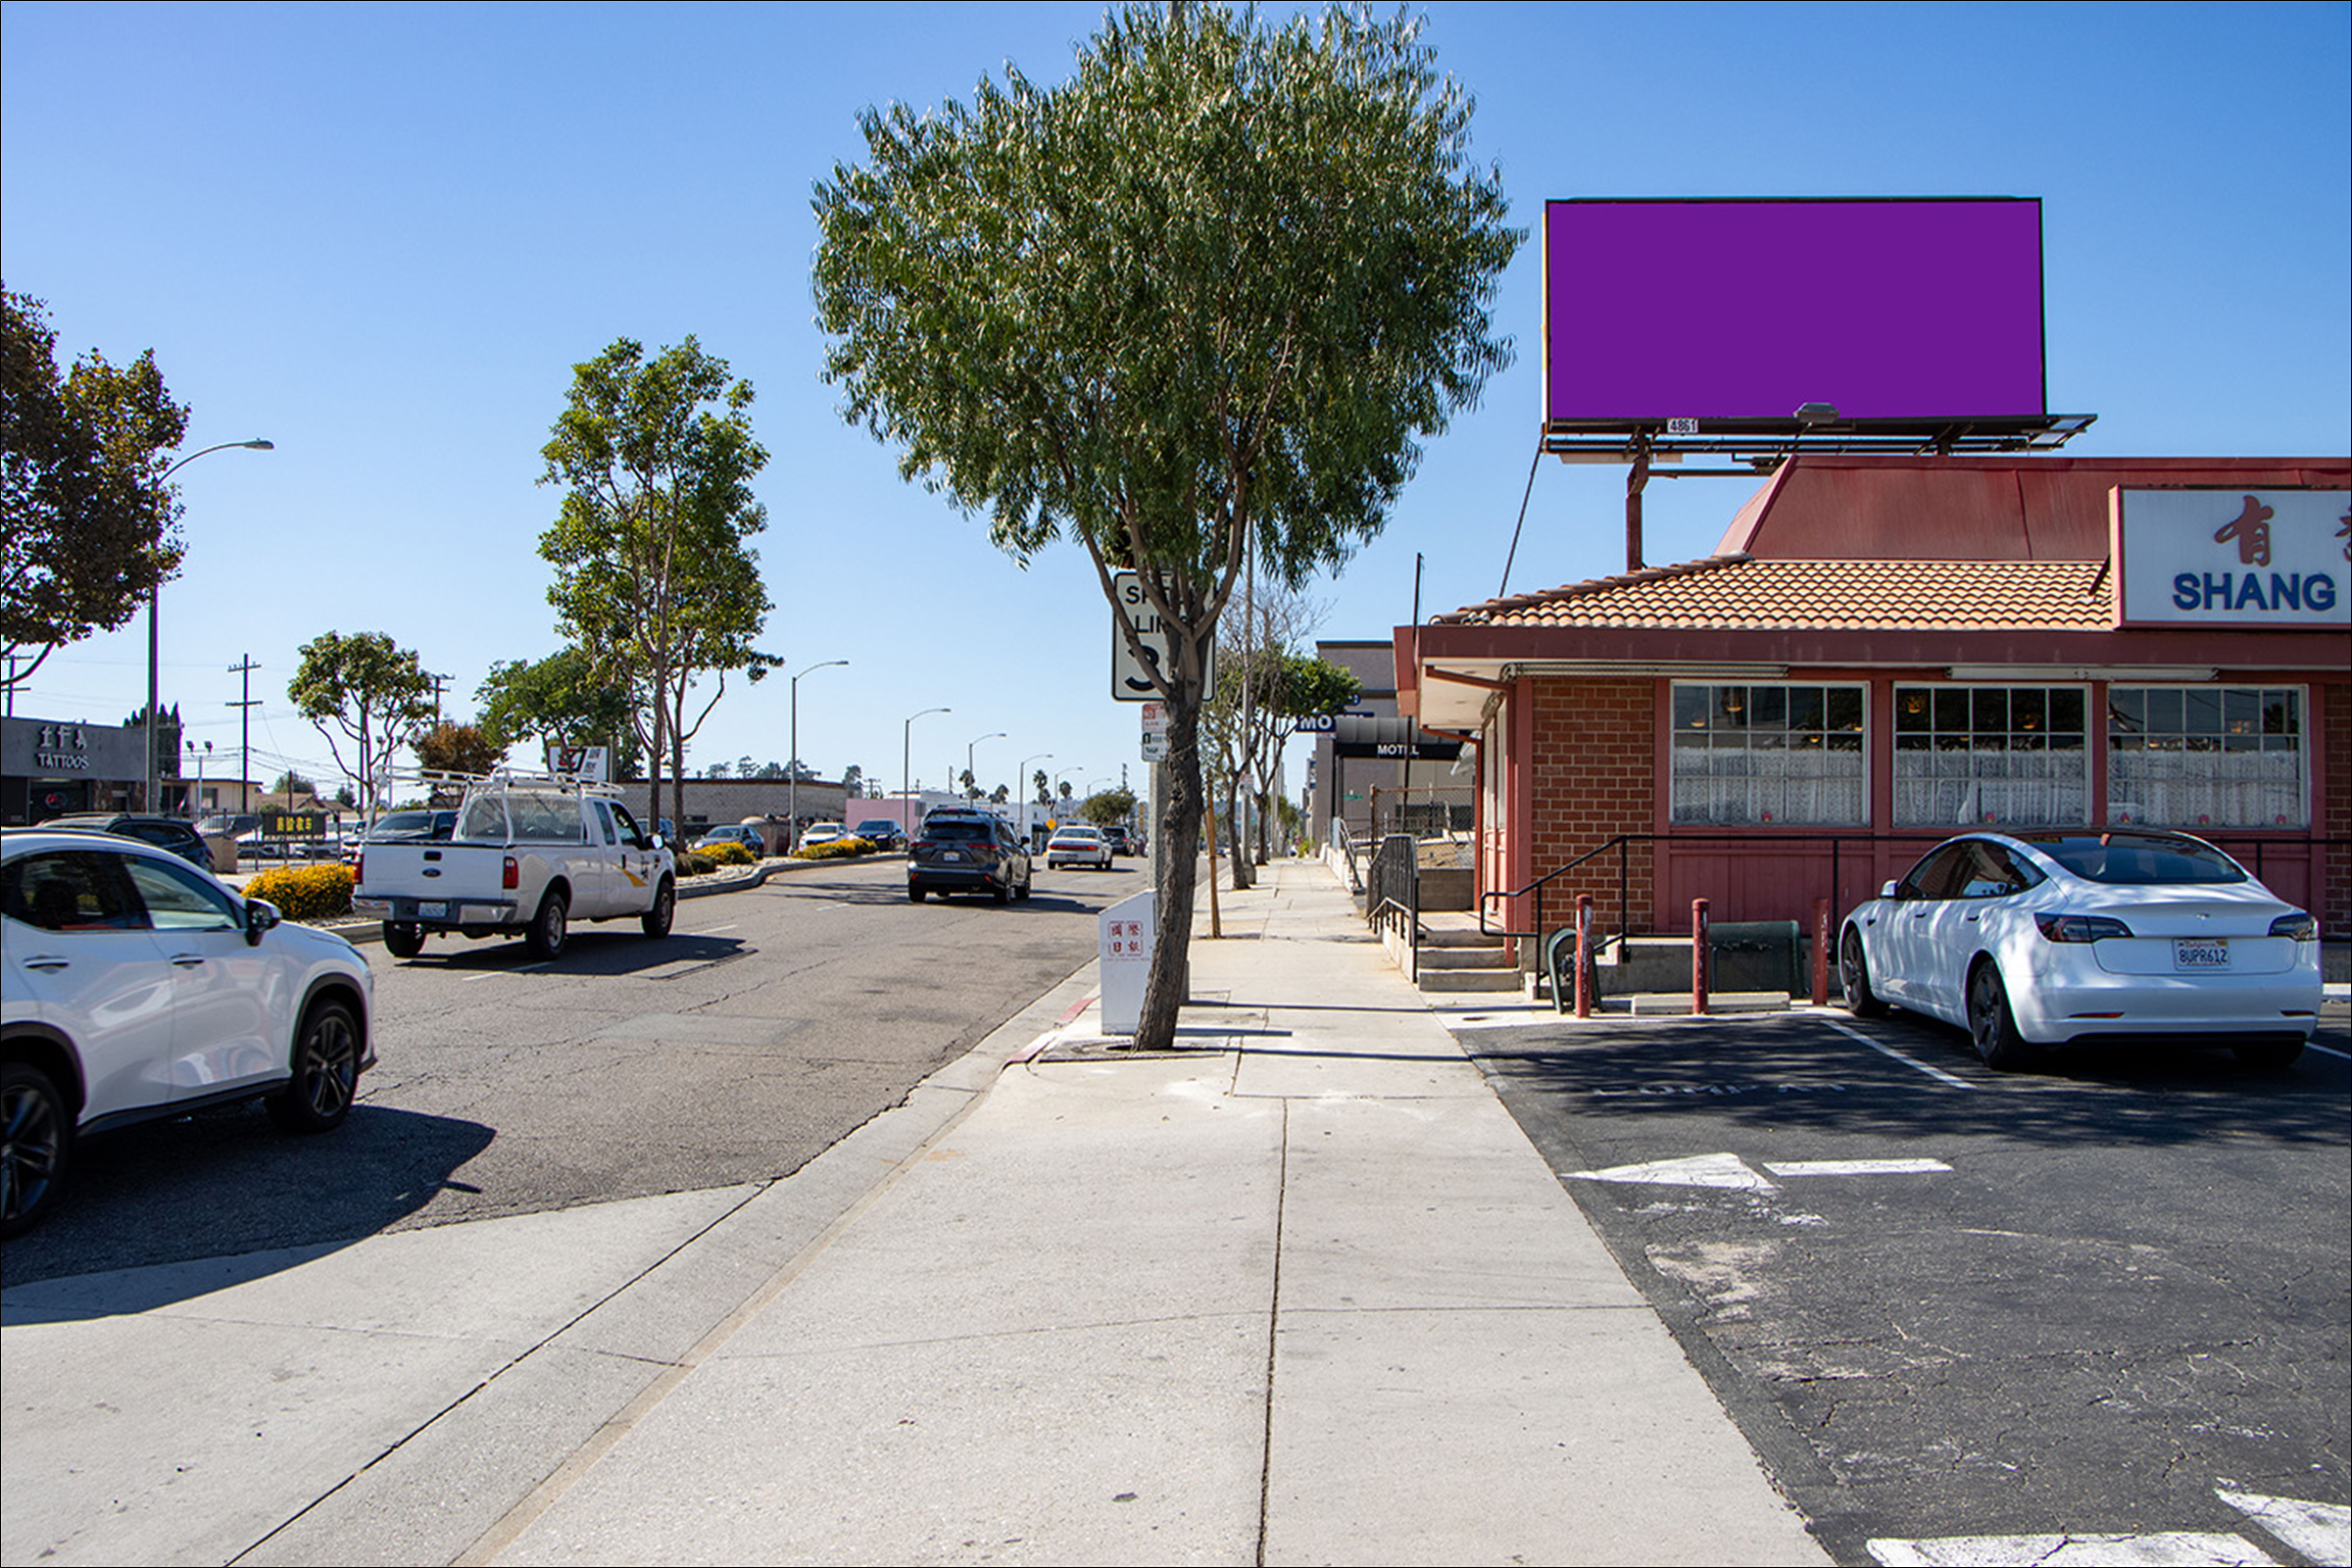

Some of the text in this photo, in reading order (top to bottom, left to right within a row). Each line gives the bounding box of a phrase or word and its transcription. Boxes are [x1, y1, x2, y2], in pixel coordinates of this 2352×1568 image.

[2173, 571, 2336, 612] SHANG
[36, 753, 90, 769] TATTOOS
[2179, 949, 2228, 963] 8UPR612
